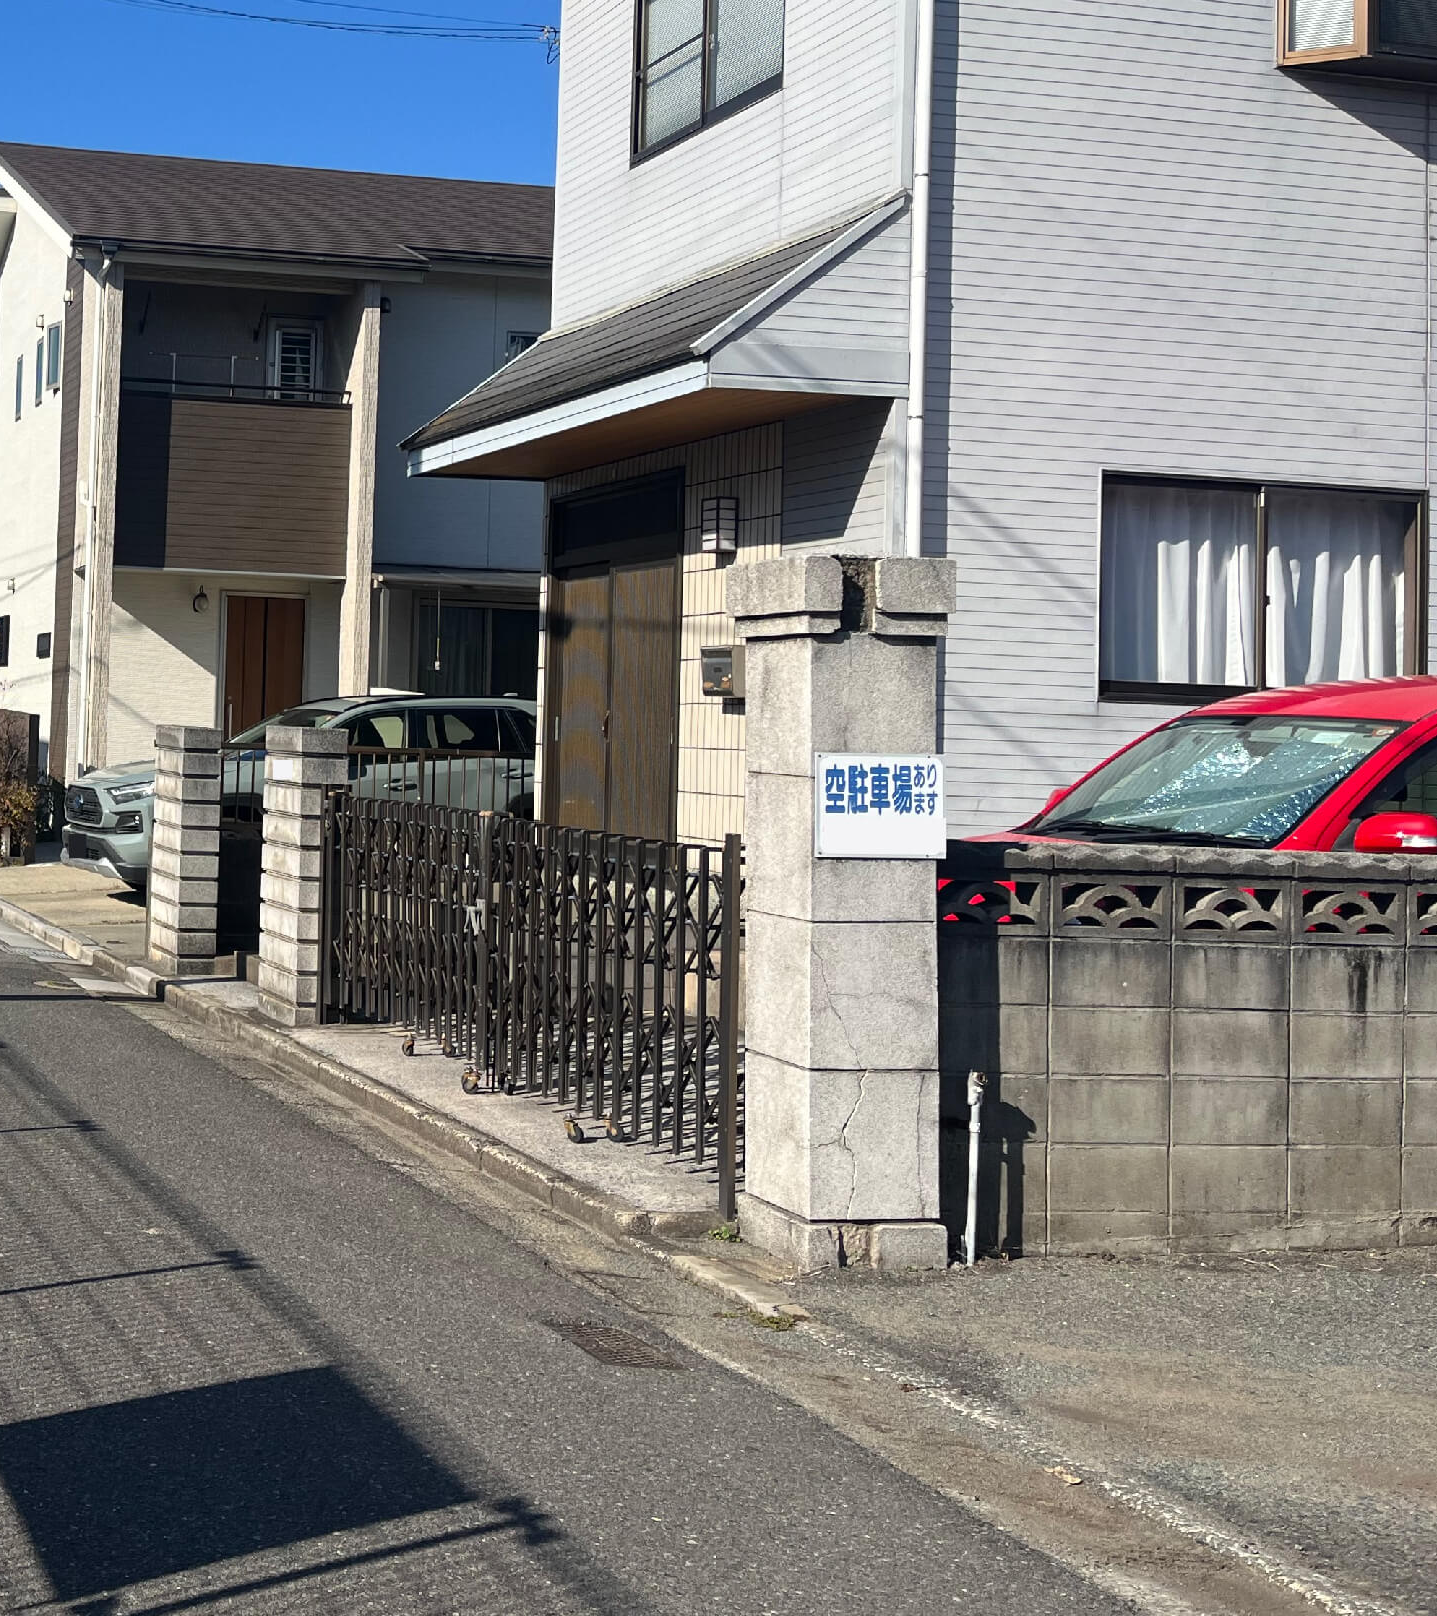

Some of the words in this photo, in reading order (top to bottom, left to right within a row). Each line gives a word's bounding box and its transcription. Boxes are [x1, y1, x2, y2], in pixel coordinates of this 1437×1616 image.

[913, 763, 938, 789] あり
[825, 763, 913, 816] 空駐車場
[913, 791, 939, 817] ます
